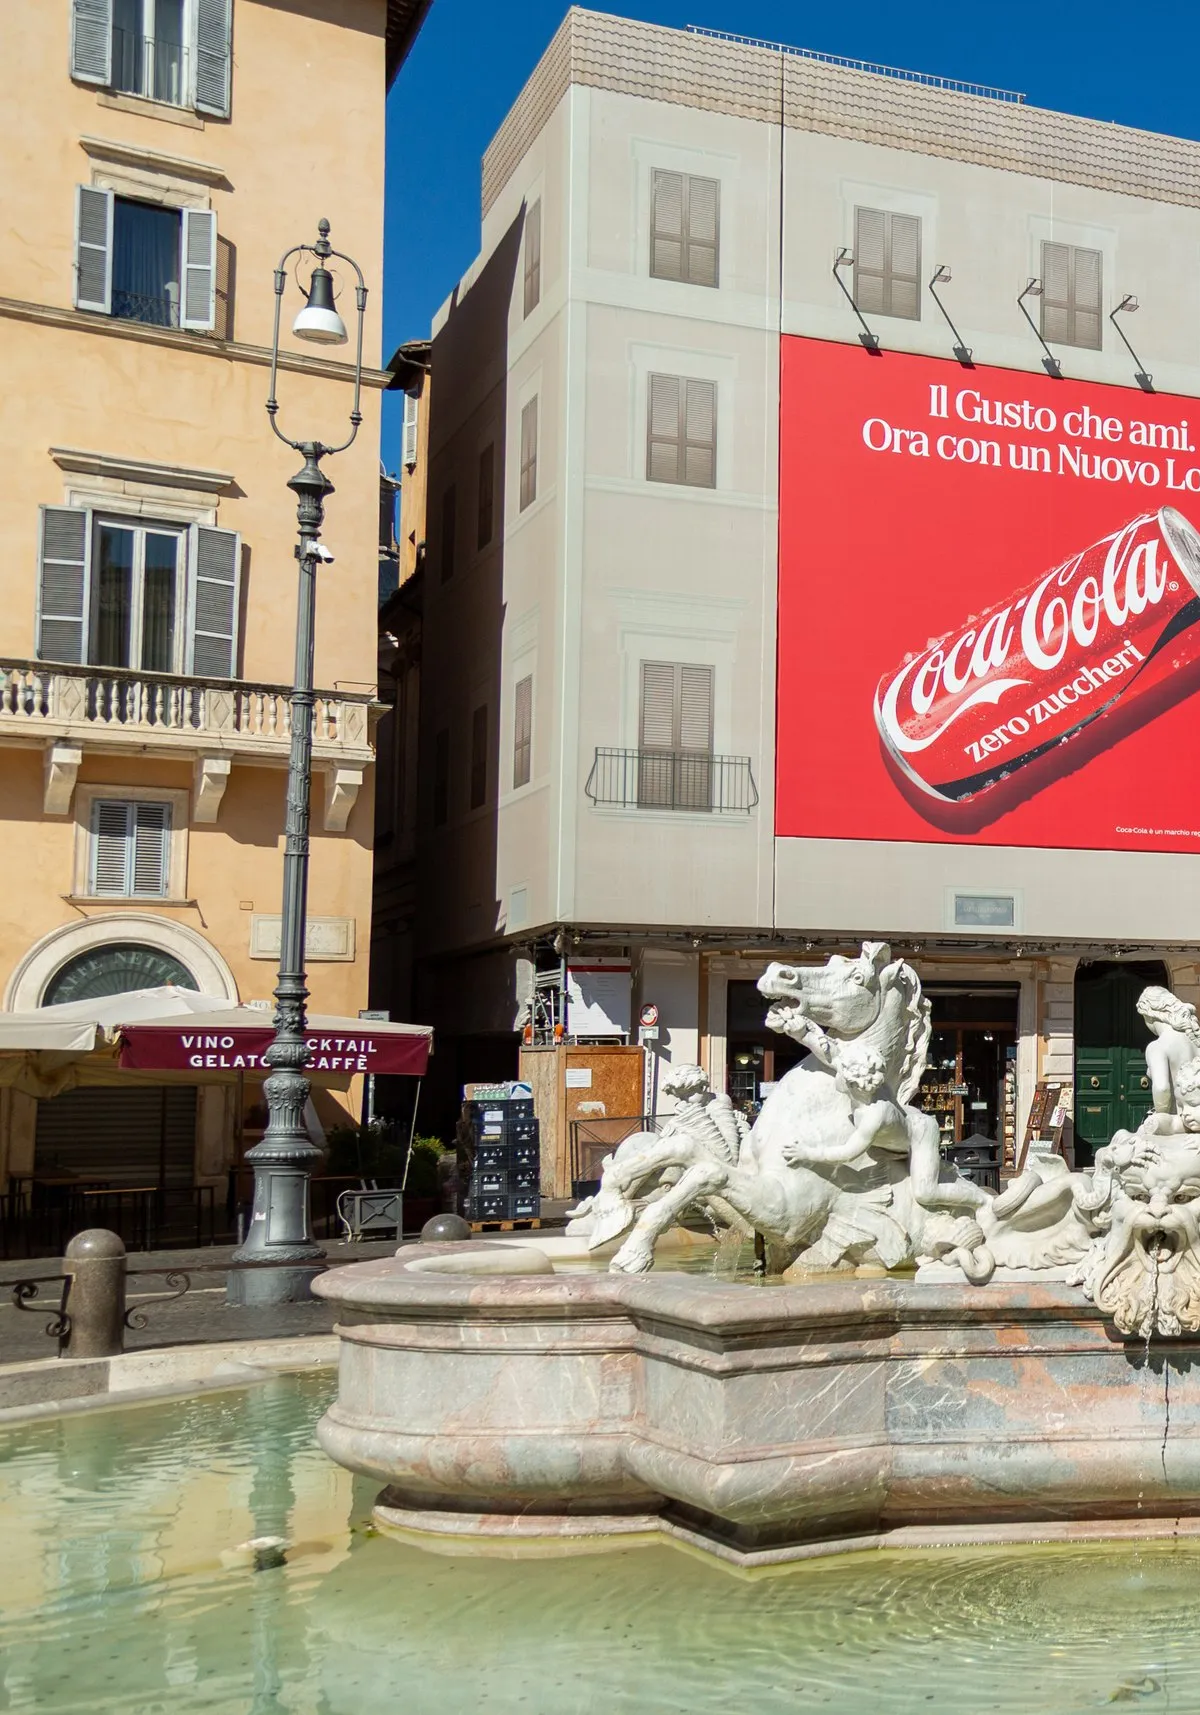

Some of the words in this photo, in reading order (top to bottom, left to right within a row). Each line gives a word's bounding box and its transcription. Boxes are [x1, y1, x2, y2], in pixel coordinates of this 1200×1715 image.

[862, 418, 930, 457] Ora
[936, 435, 1002, 467] con
[1008, 444, 1052, 473] un
[1058, 443, 1161, 487] Nuovo
[928, 384, 949, 419] Il
[955, 389, 1057, 433] Gusto
[1063, 406, 1124, 442] che
[1129, 420, 1196, 453] ami.
[881, 513, 1171, 754] Coca-Cola
[963, 716, 1030, 764] zero
[1025, 639, 1147, 725] zuccheri
[1115, 826, 1148, 834] Coca-Cola
[181, 1035, 235, 1049] VINO
[306, 1038, 378, 1053] CKTAIL
